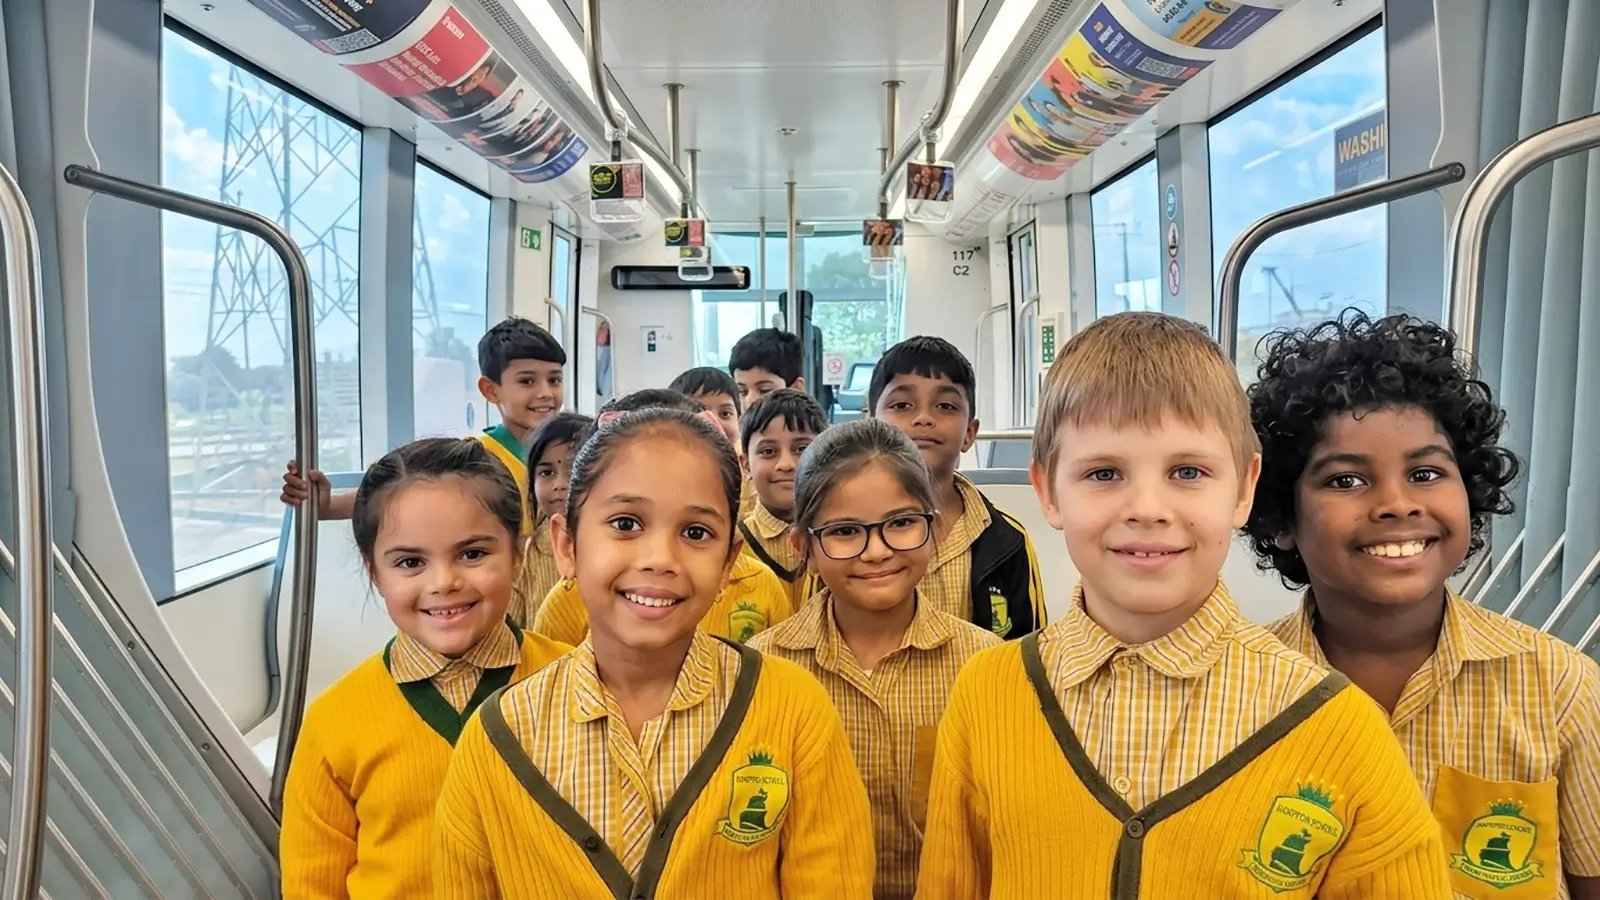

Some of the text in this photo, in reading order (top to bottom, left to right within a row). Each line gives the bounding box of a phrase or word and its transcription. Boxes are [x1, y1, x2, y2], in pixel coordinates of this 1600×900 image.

[1338, 122, 1386, 164] WASHI
[952, 250, 974, 261] 117
[952, 265, 970, 276] C2
